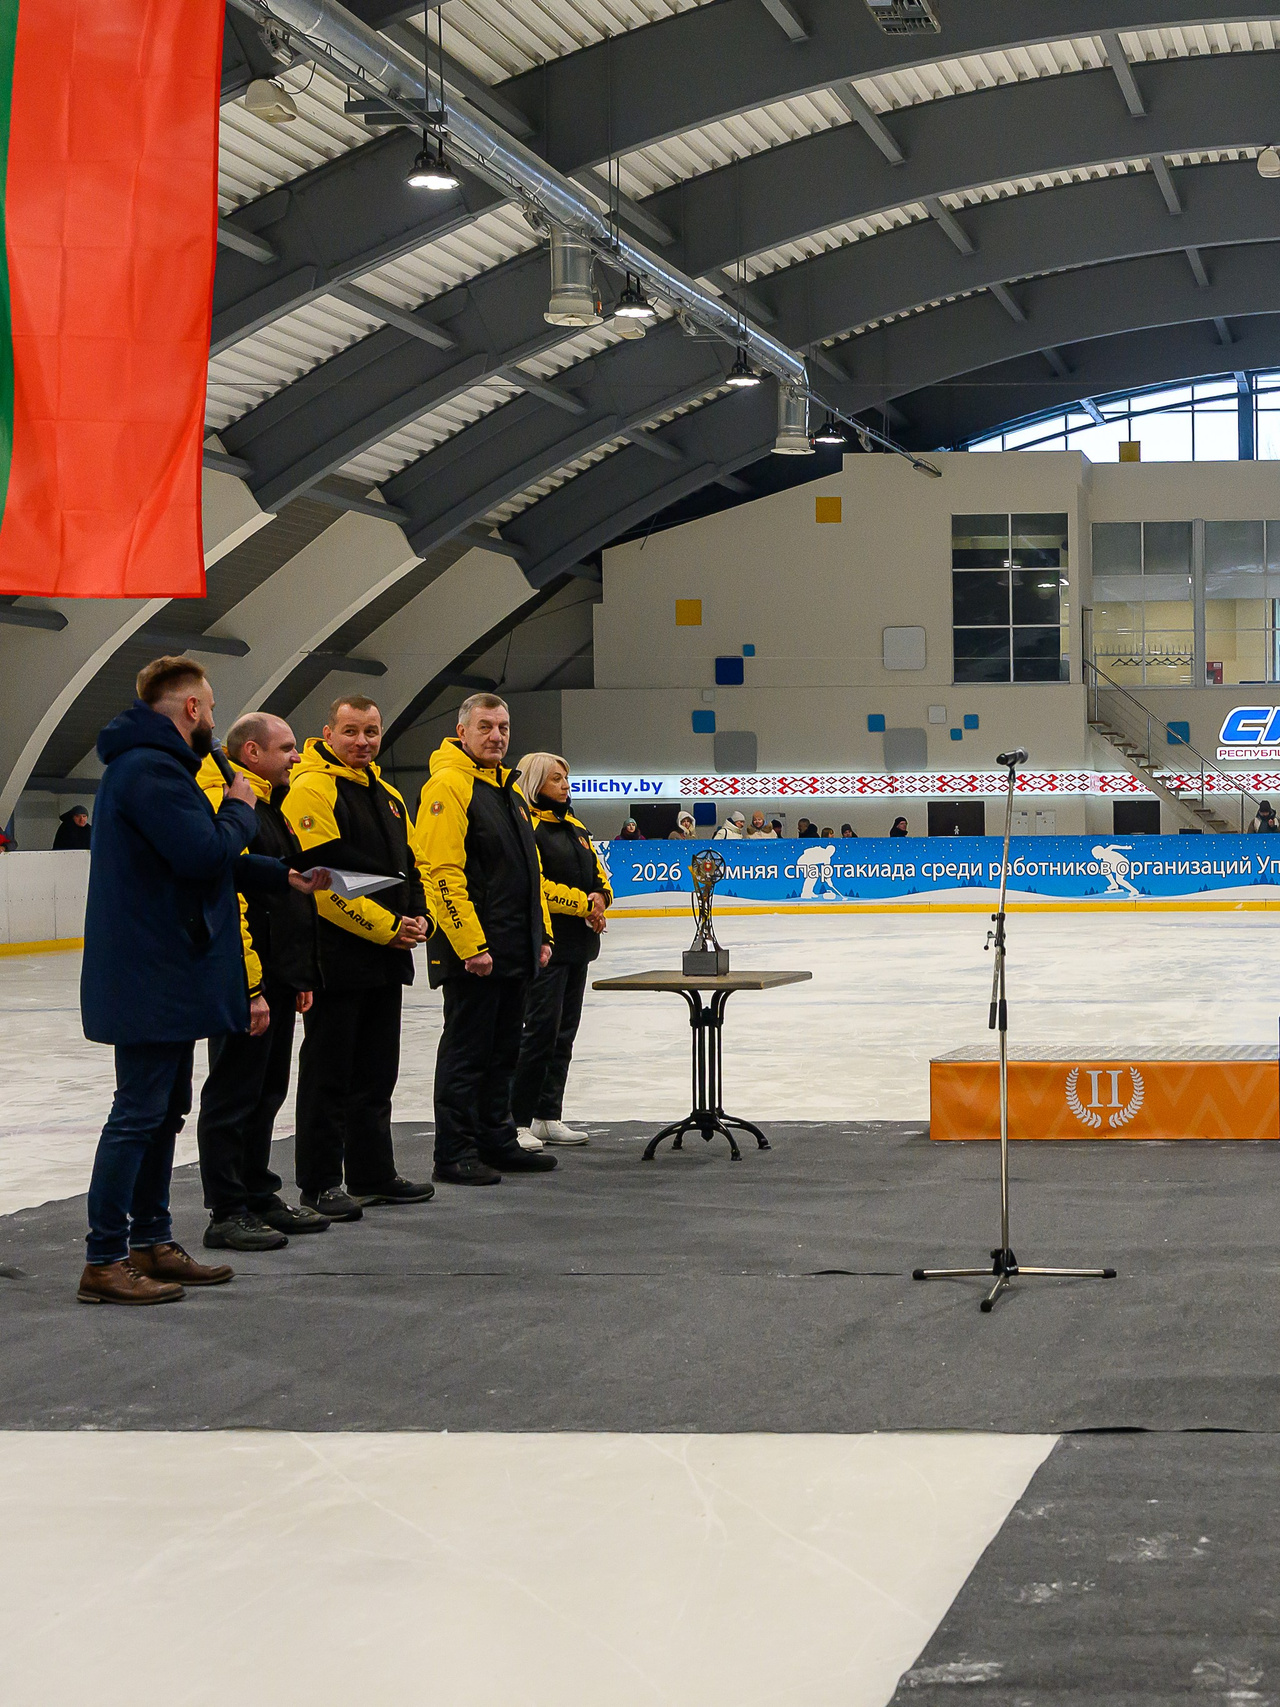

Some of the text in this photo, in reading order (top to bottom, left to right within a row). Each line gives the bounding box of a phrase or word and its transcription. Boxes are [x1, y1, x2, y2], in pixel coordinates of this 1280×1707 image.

[570, 779, 663, 795] silichy.by
[631, 862, 682, 882] 2026
[719, 865, 778, 880] мняя
[783, 862, 916, 882] спартакиада
[920, 861, 983, 882] среди
[988, 855, 1112, 881] работников
[1116, 855, 1251, 880] организаций
[330, 893, 375, 931] BELARUS
[438, 879, 463, 929] BELARUS
[544, 891, 579, 908] LARUS
[1085, 1069, 1125, 1108] II
